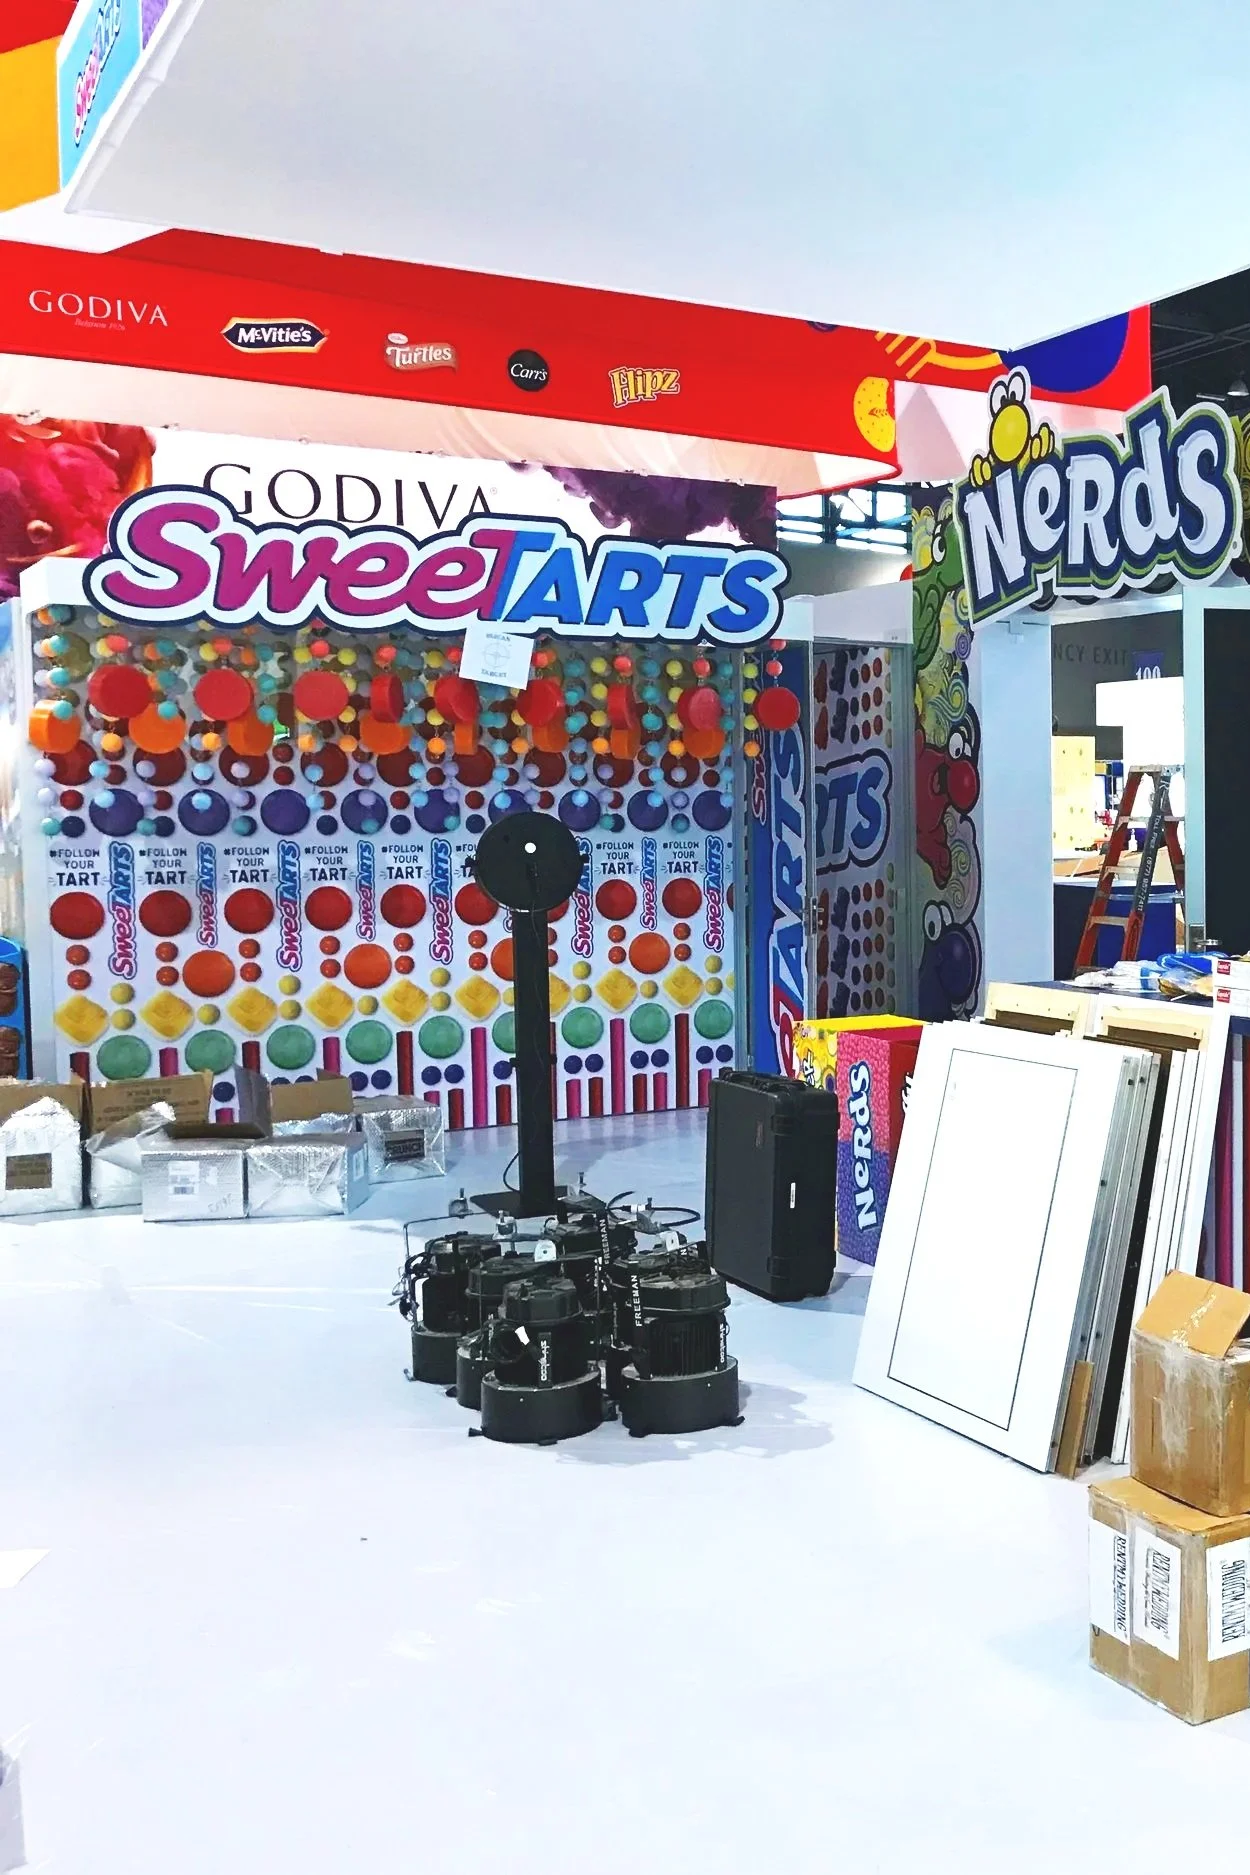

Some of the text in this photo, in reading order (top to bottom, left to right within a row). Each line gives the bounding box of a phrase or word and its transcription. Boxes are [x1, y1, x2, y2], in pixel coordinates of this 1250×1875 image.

[28, 289, 168, 327] GODIVA
[237, 326, 312, 344] McVitie's
[386, 345, 452, 368] Turtles
[510, 363, 548, 382] Carr's
[611, 367, 680, 408] Flipz
[203, 462, 492, 528] GODIVA
[304, 846, 348, 855] #FOLLOW
[382, 845, 424, 854] #FOLLOW
[596, 842, 634, 851] #FOLLOW
[662, 841, 700, 850] #FOLLOW
[139, 848, 188, 857] #FOLLOW
[223, 847, 270, 857] #FOLLOW
[606, 851, 630, 861] YOUR
[672, 850, 695, 860] YOUR
[64, 859, 95, 870] YOUR
[152, 859, 182, 868] YOUR
[237, 858, 265, 868] YOUR
[316, 856, 343, 865] YOUR
[393, 855, 419, 864] YOUR
[386, 866, 423, 879] TART
[600, 862, 634, 875] TART
[667, 862, 700, 874] TART
[56, 872, 101, 886] TART
[145, 871, 187, 885] TART
[229, 869, 270, 884] TART
[310, 868, 348, 882] TART
[600, 1219, 611, 1265] FREEMAN
[631, 1274, 643, 1327] FREEMAN
